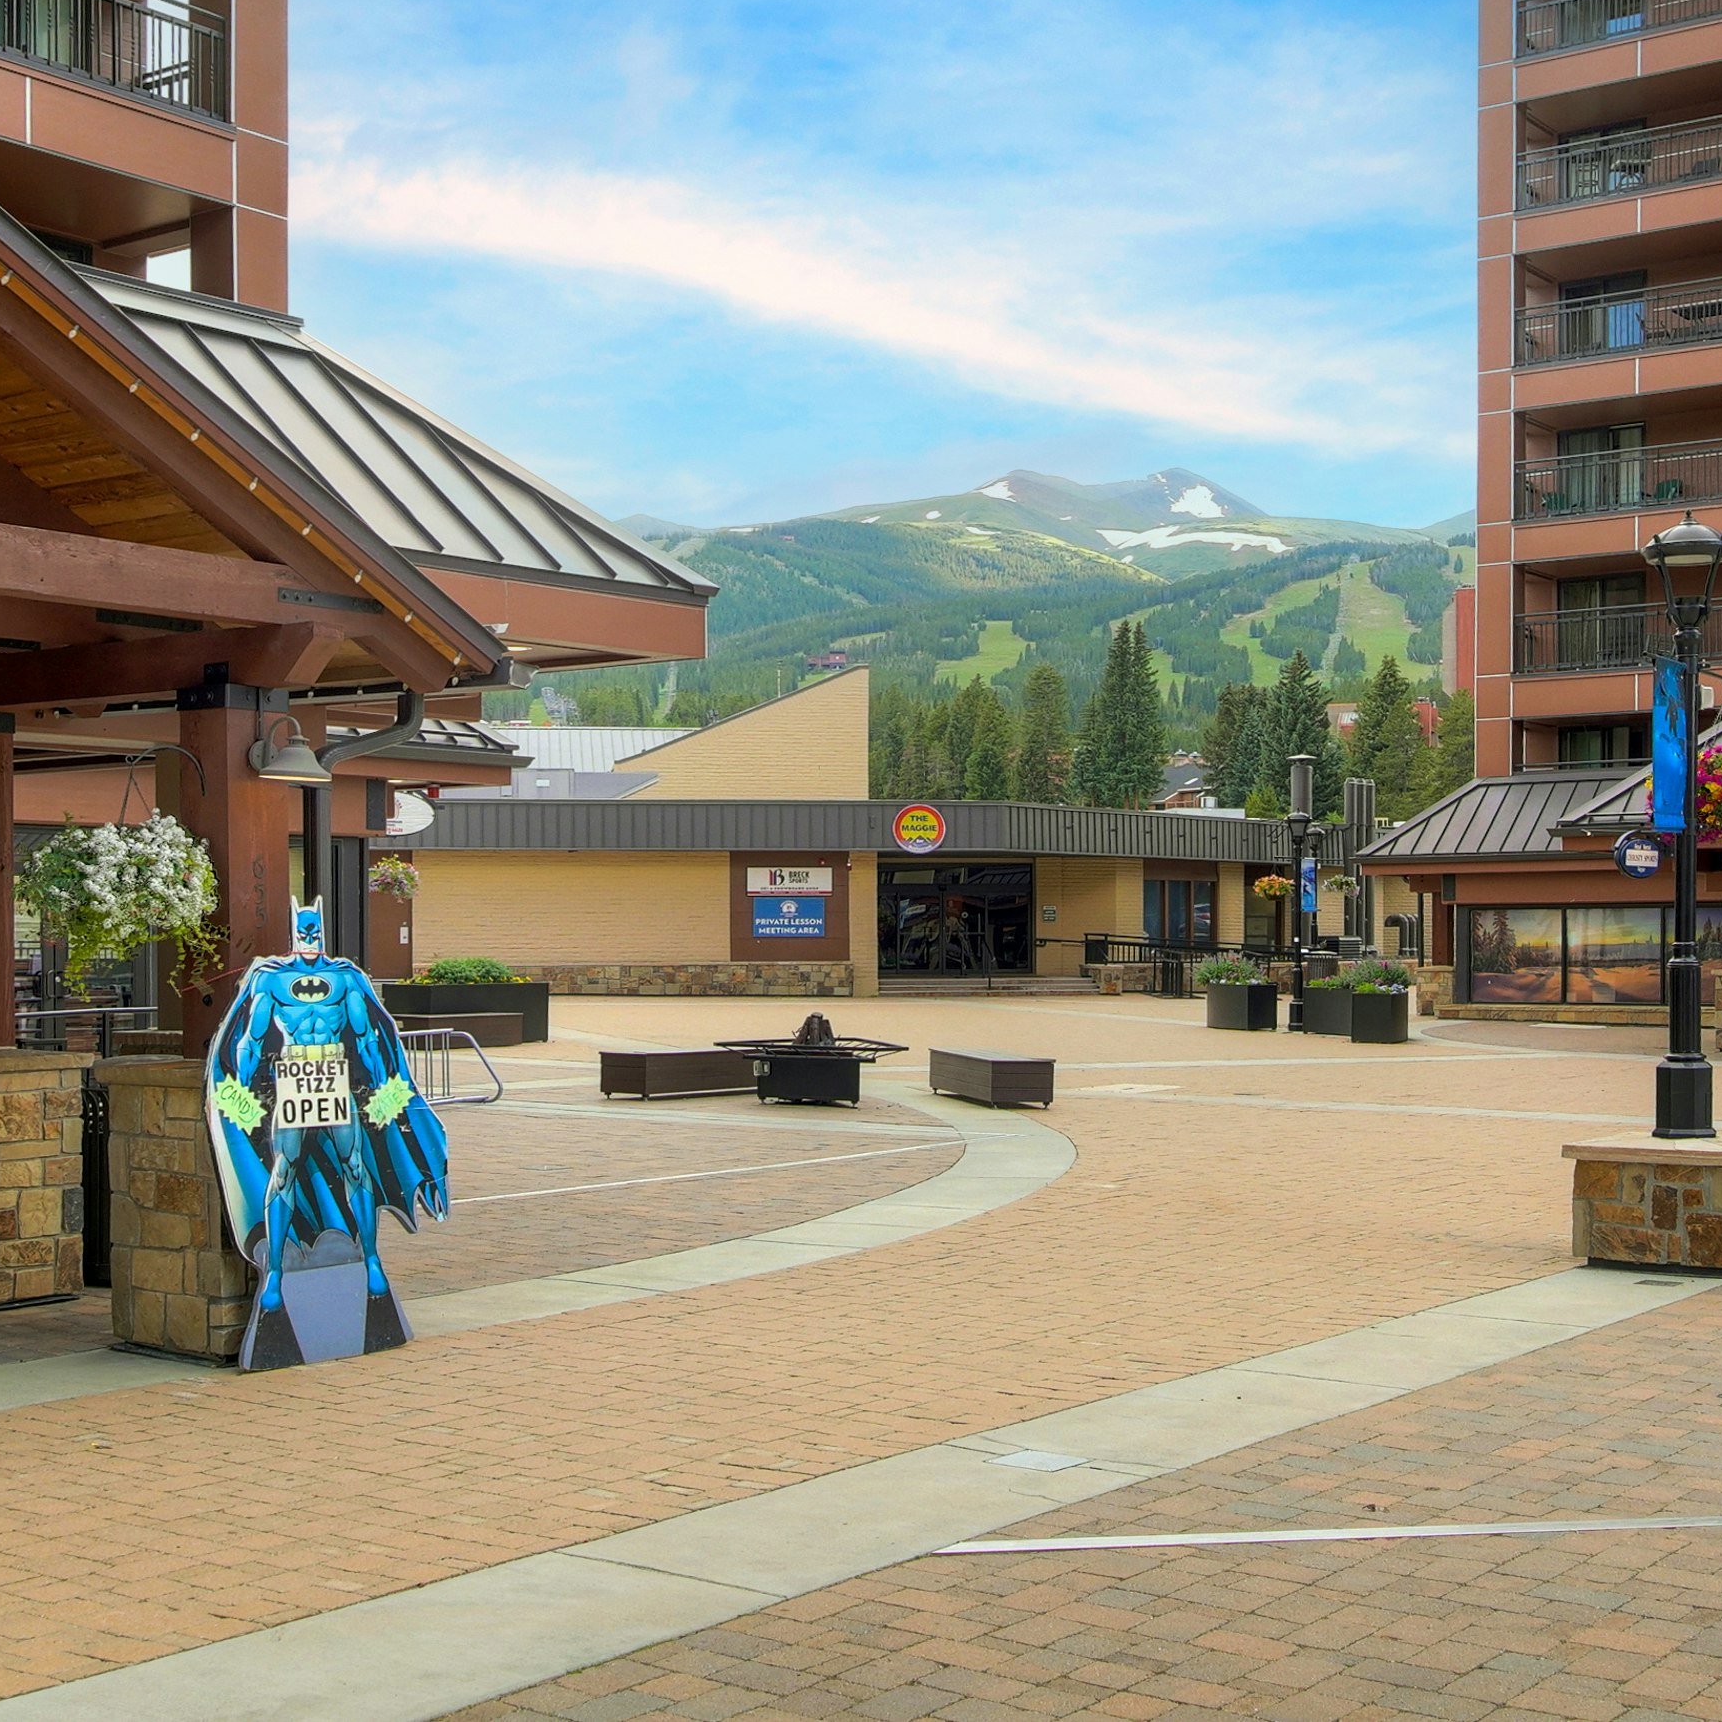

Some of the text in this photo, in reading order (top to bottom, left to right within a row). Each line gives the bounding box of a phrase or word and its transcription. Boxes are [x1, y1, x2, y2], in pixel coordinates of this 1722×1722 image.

[901, 824, 937, 832] MAGGIE
[277, 1059, 347, 1079] ROCKET
[295, 1077, 337, 1094] FIZZ
[219, 1084, 260, 1124] CANDY
[282, 1096, 348, 1125] OPEN
